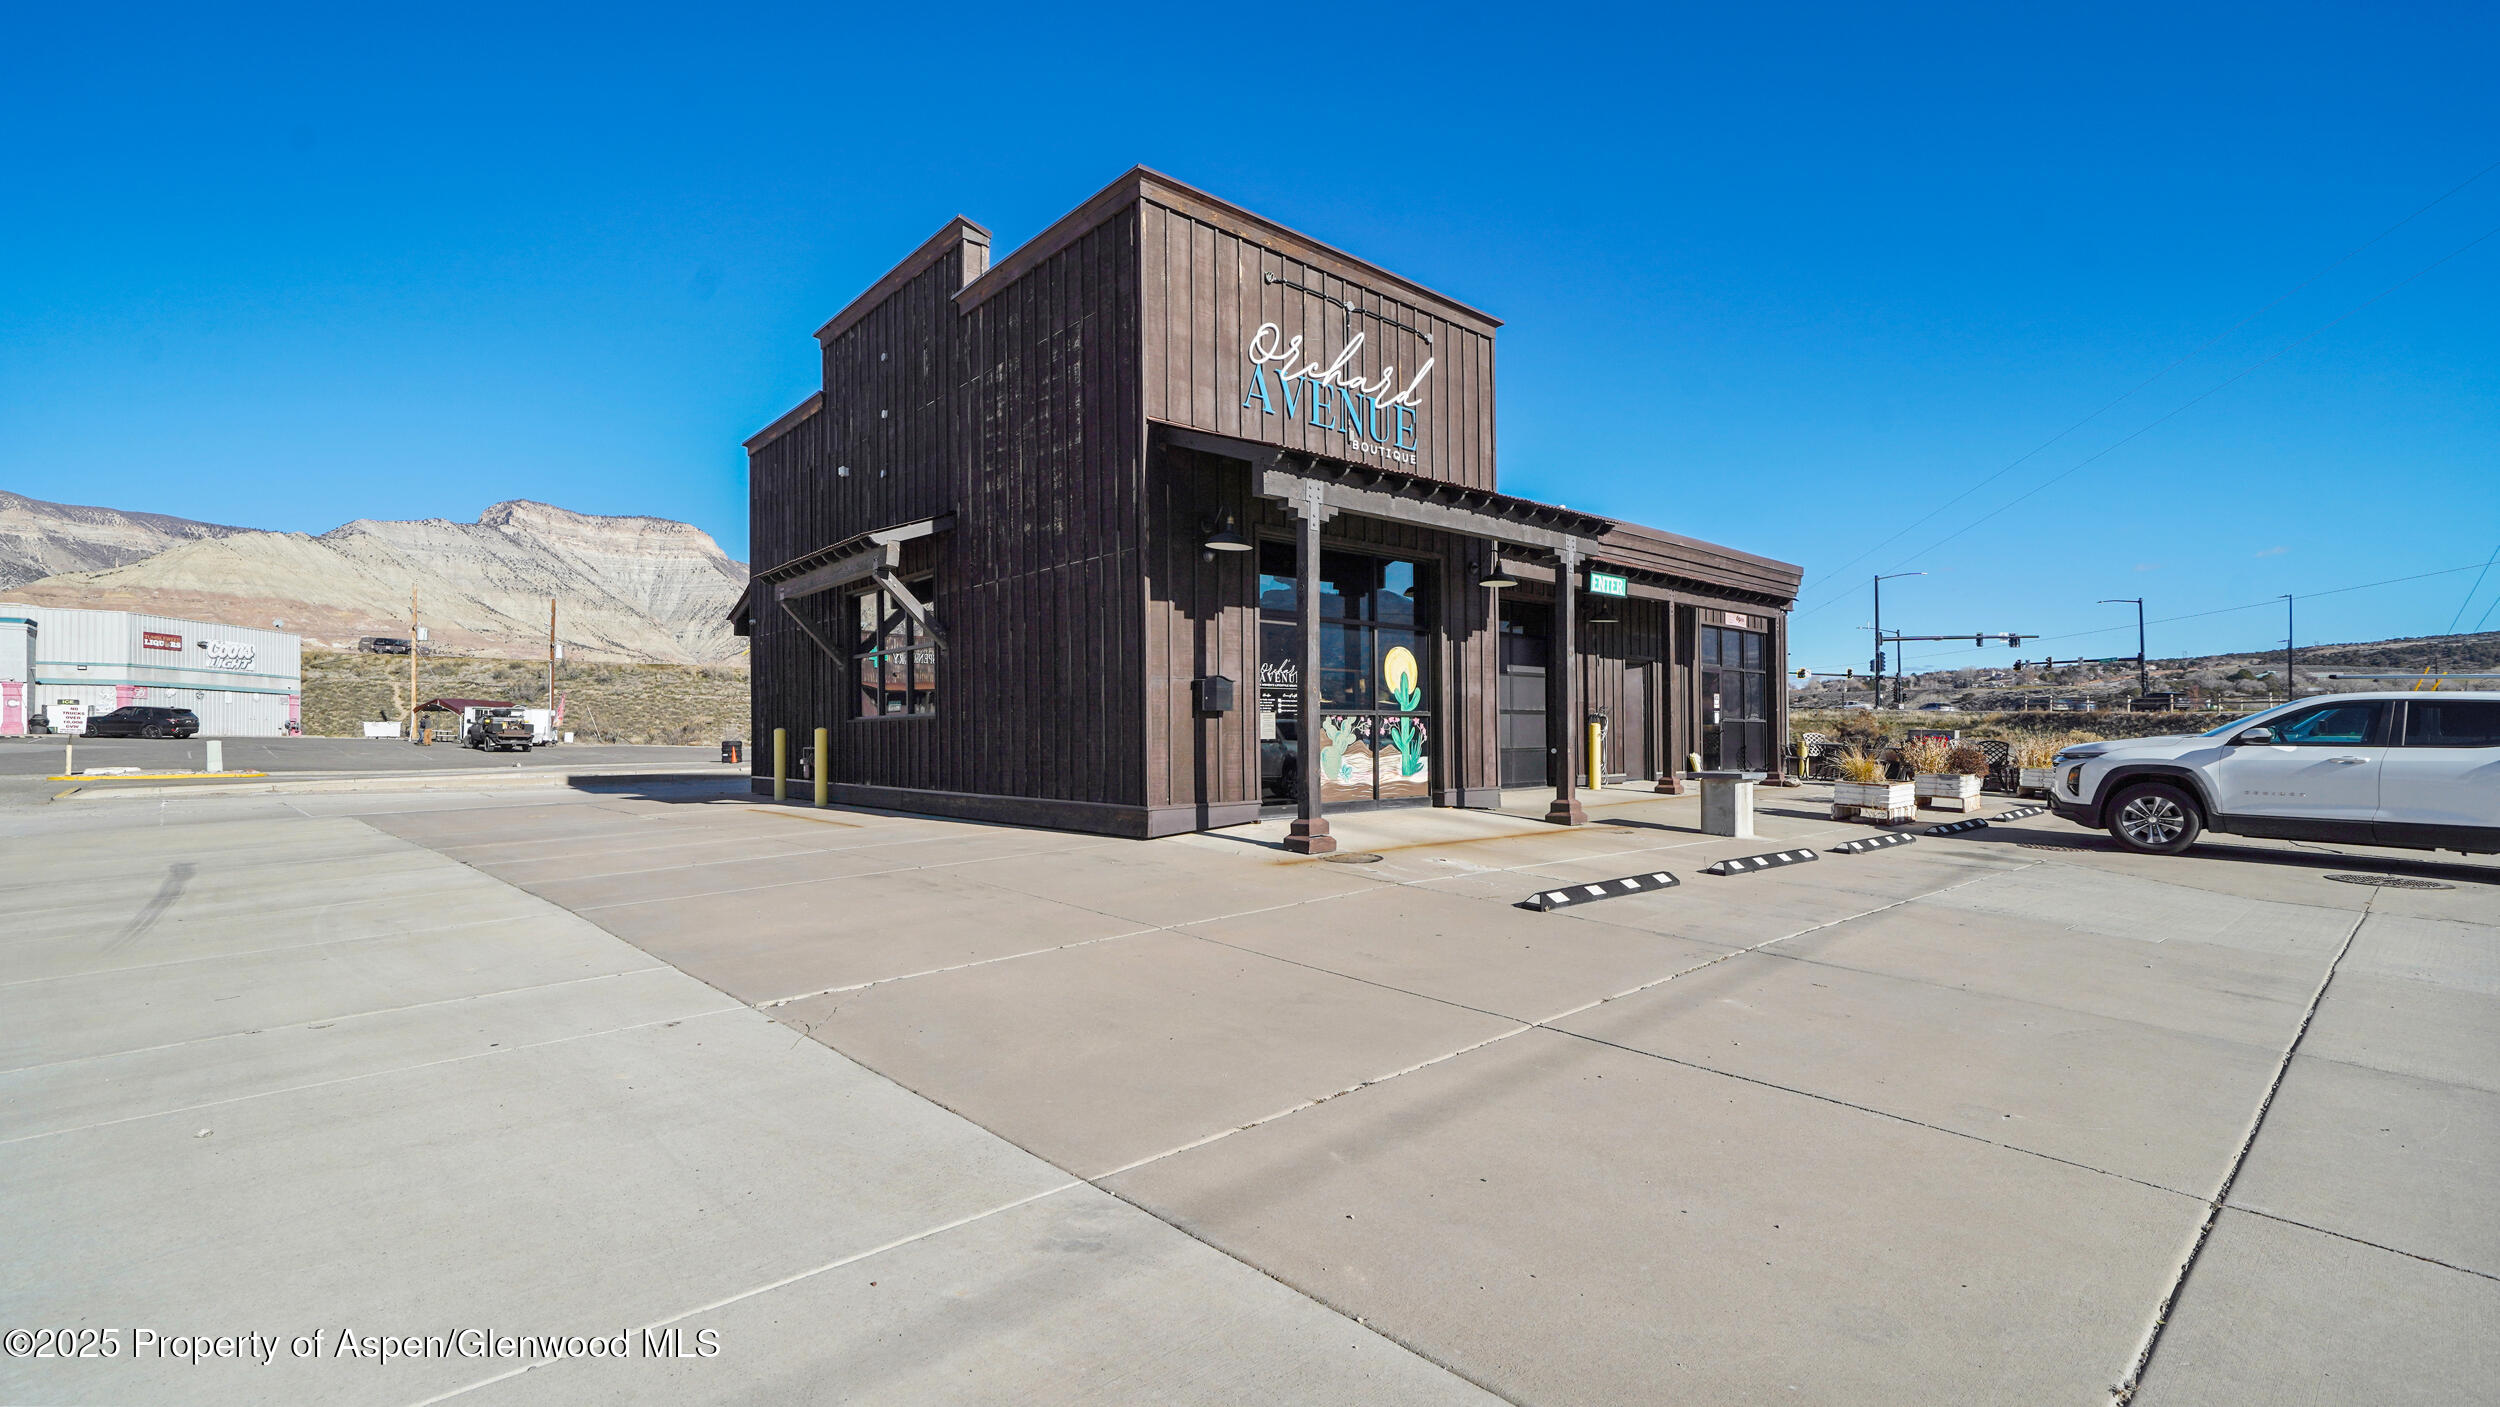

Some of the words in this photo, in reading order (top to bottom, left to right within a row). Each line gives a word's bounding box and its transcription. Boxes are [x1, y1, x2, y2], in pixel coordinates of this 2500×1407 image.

[1249, 322, 1434, 409] Orchard
[1242, 363, 1418, 452] AVENUE
[1351, 439, 1417, 465] BOUTIQUE
[1592, 574, 1625, 595] ENTER
[144, 639, 181, 648] LIQURS
